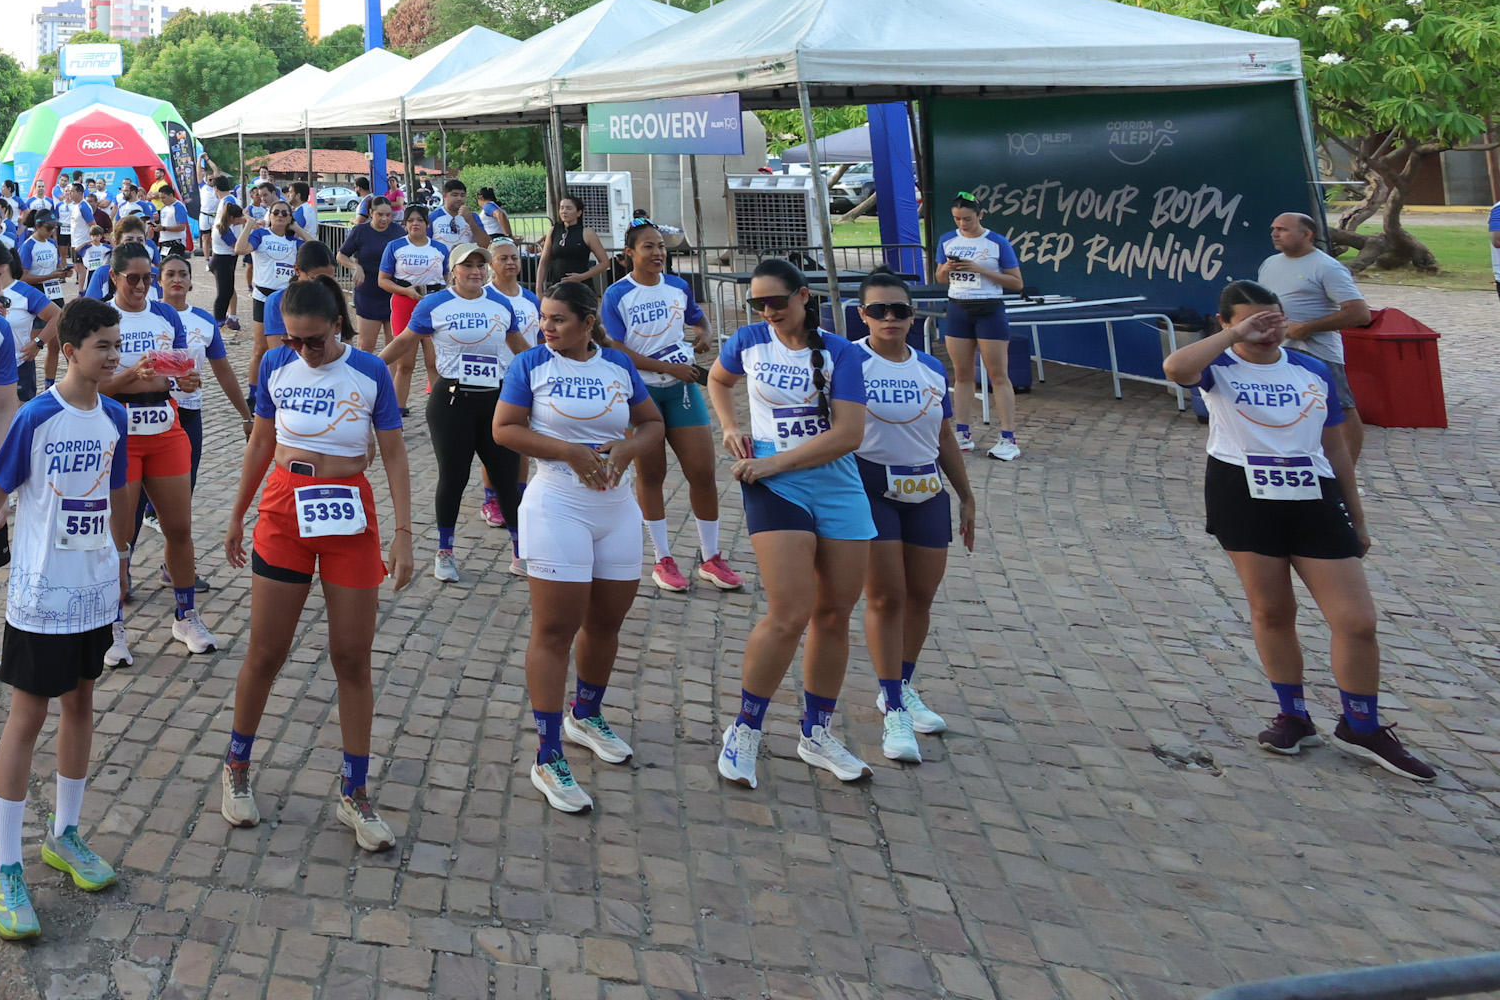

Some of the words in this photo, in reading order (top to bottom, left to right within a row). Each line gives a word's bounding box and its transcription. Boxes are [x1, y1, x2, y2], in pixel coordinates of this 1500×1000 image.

[609, 111, 709, 140] RECOVERY
[1106, 120, 1153, 132] CORRIDA
[1006, 132, 1041, 156] 190
[1041, 132, 1072, 143] ALEPI
[1108, 131, 1153, 145] ALEPI
[974, 180, 1060, 220] RESET
[1057, 184, 1142, 227] YOUR
[266, 244, 289, 253] ALEPI
[1004, 227, 1074, 272] KEEP
[628, 300, 667, 315] CORRIDA
[445, 313, 487, 322] CORRIDA
[448, 319, 488, 330] ALEPI
[631, 308, 668, 326] ALEPI
[119, 331, 154, 341] ORRIDA
[464, 364, 497, 378] 5541
[753, 361, 810, 377] CORRIDA
[547, 376, 603, 387] CORRIDA
[755, 372, 810, 393] ALEPI
[863, 379, 919, 390] CORRIDA
[1230, 381, 1295, 393] CORRIDA
[274, 387, 336, 400] CORRIDA
[549, 384, 606, 401] ALEPI
[866, 388, 921, 405] ALEPI
[1235, 391, 1301, 407] ALEPI
[280, 399, 337, 418] ALEPI
[132, 410, 168, 424] 5120
[777, 417, 831, 439] 5459
[45, 439, 102, 455] CORRIDA
[48, 453, 102, 475] ALEPI
[893, 476, 940, 495] 1040
[1253, 470, 1316, 488] 5552
[303, 502, 355, 522] 5339
[66, 515, 105, 536] 5511
